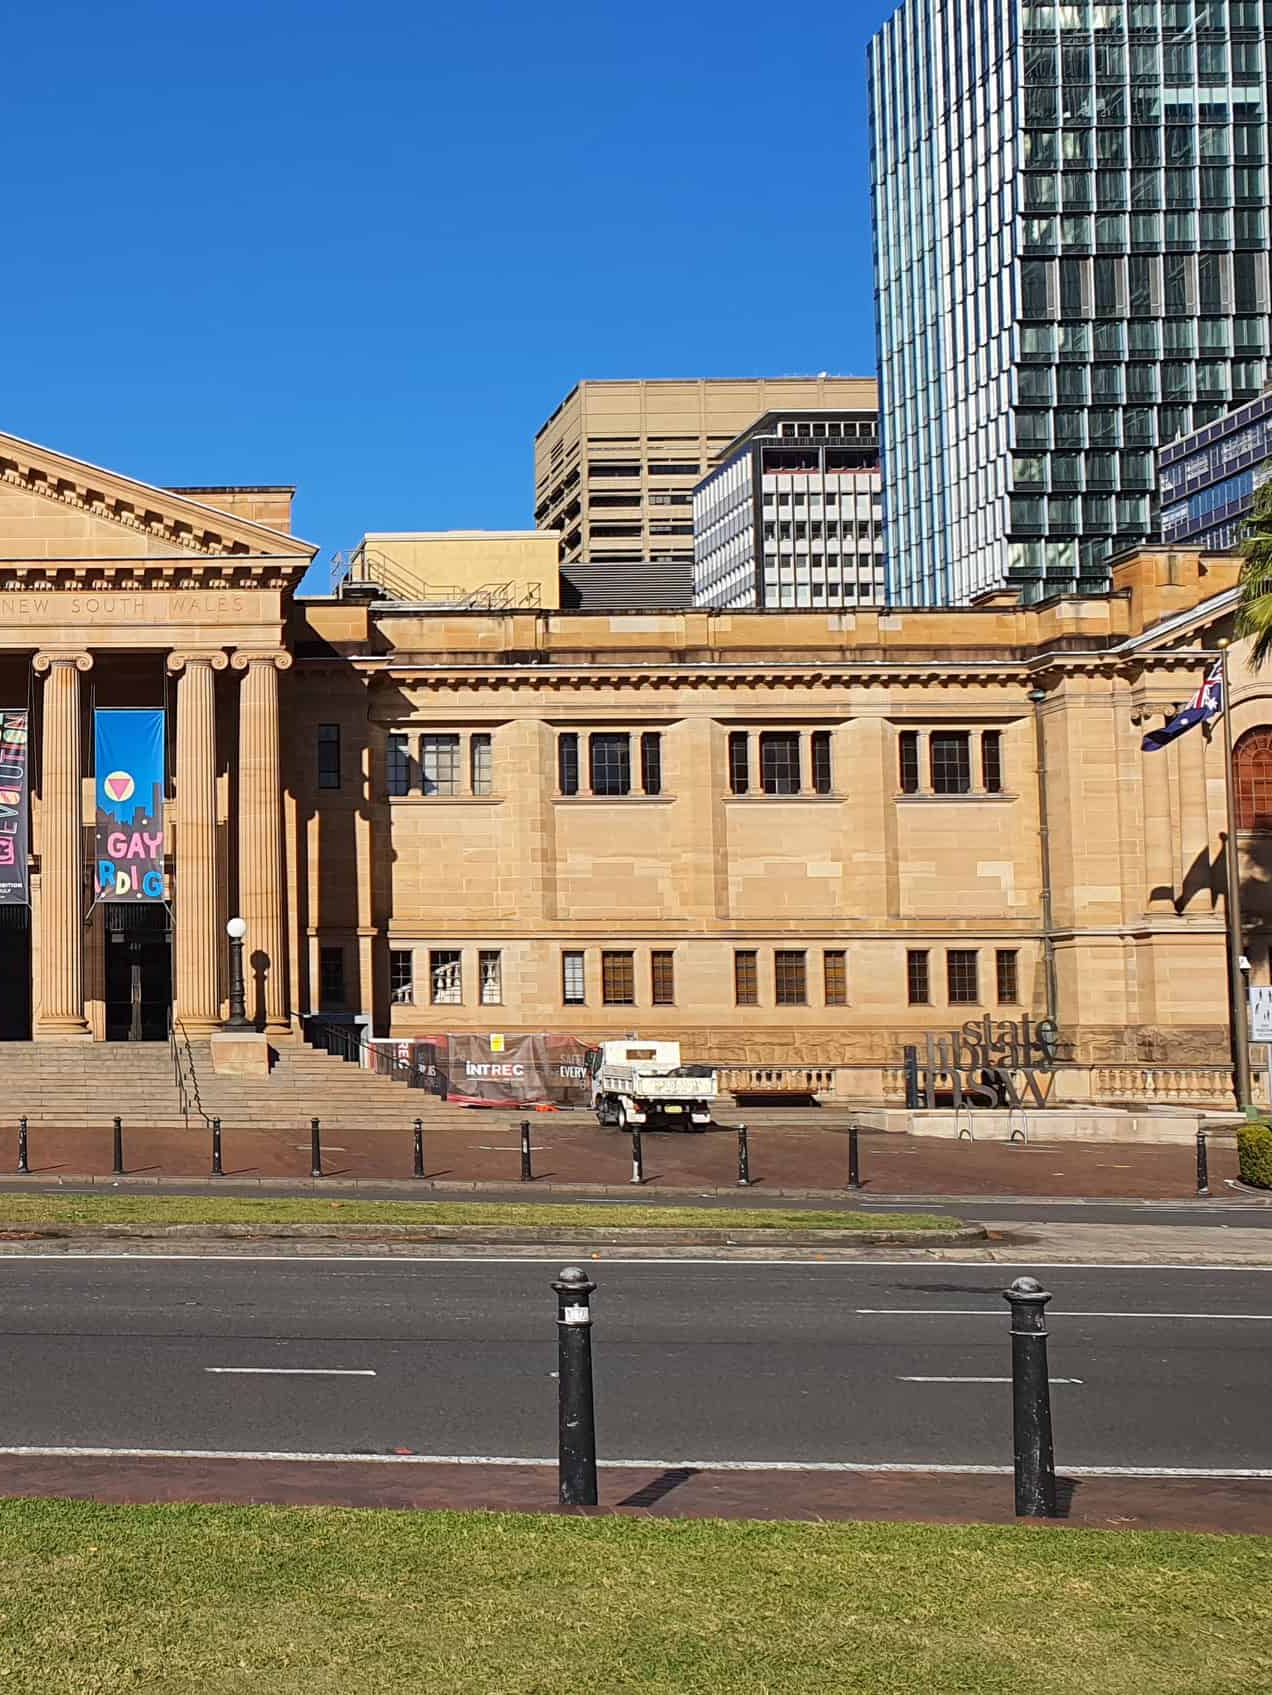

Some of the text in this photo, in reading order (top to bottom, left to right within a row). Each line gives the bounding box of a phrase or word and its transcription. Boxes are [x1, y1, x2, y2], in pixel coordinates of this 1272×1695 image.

[2, 599, 49, 613] NEW
[71, 598, 145, 613] SOUTH
[169, 597, 244, 612] WALES
[107, 831, 163, 859] GAY
[962, 1013, 1059, 1052] state
